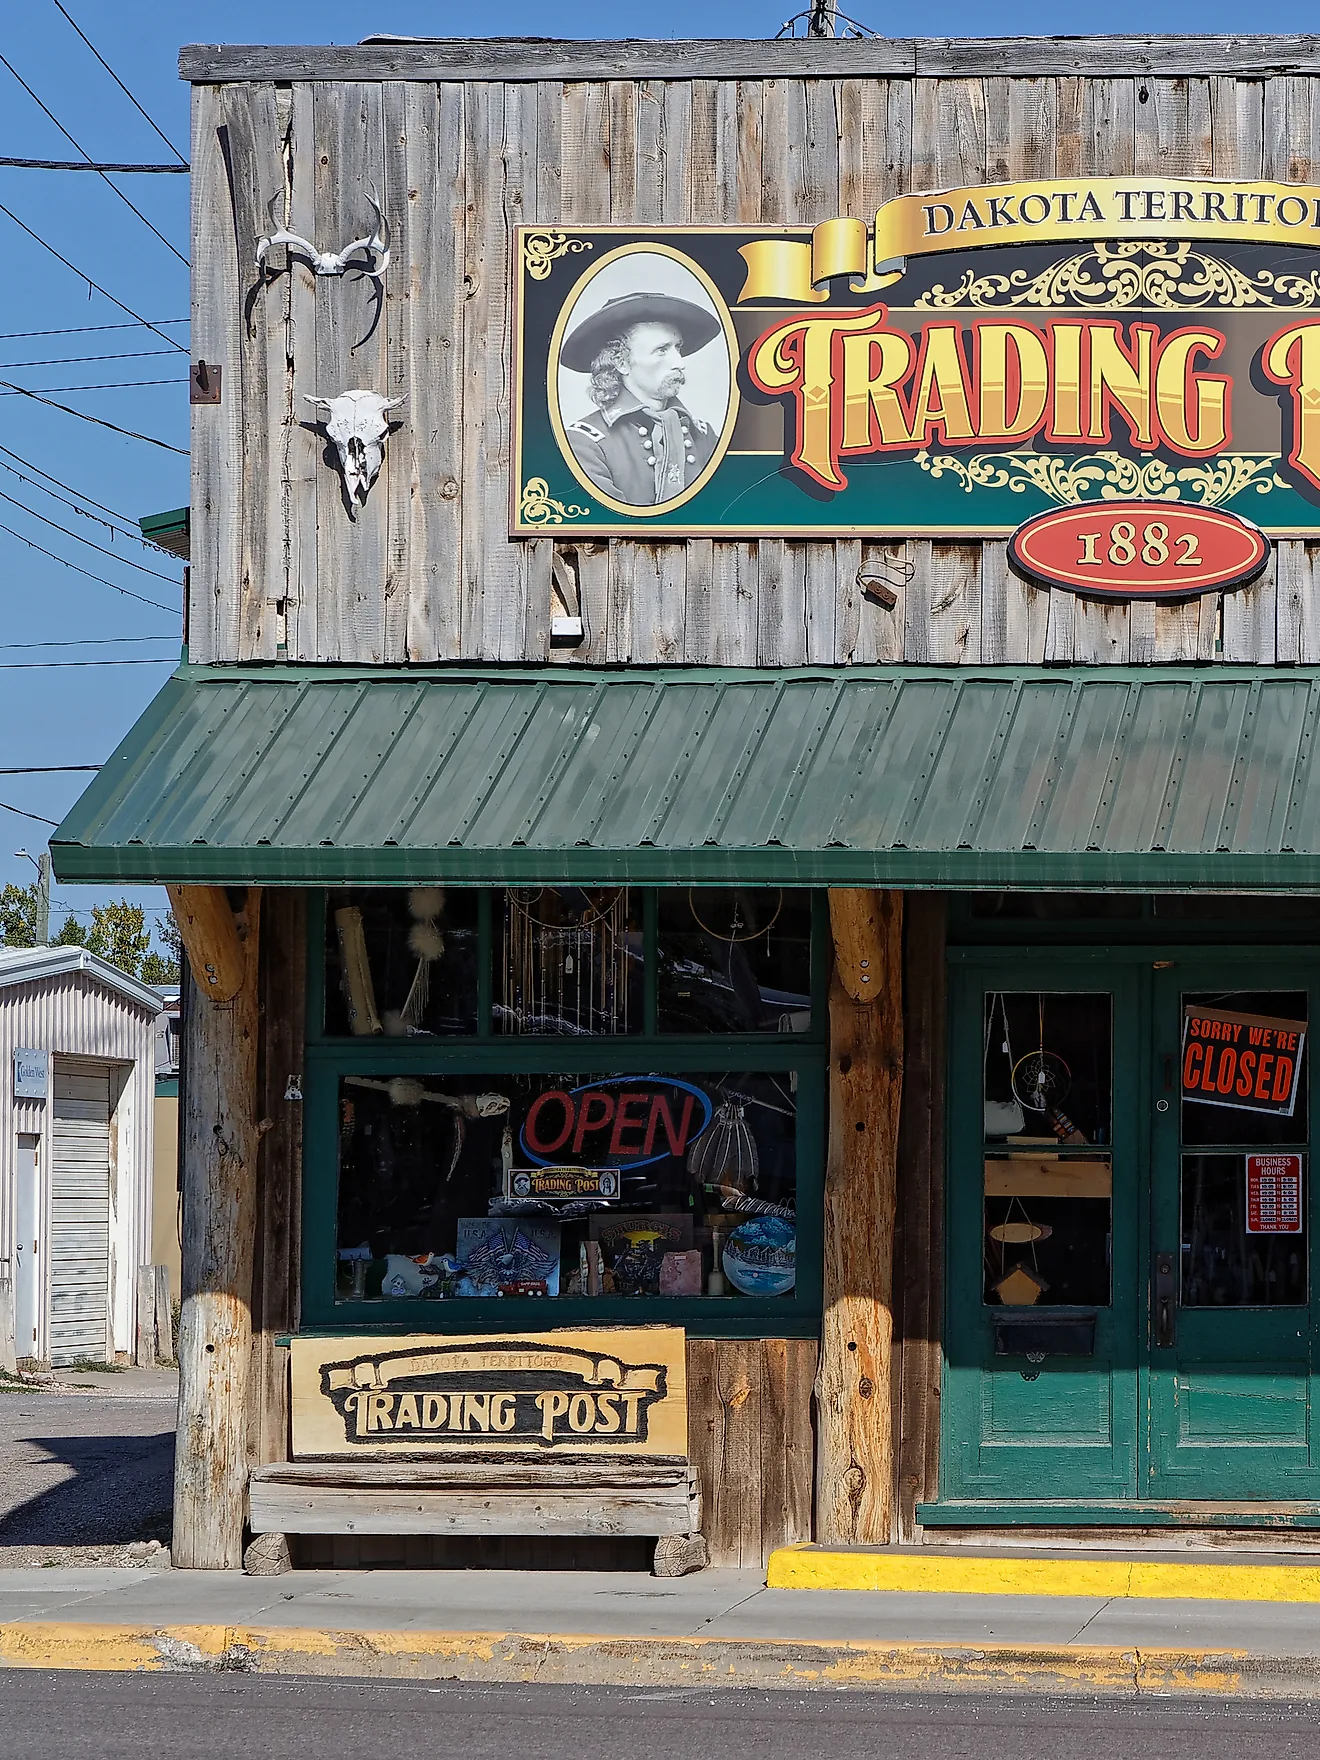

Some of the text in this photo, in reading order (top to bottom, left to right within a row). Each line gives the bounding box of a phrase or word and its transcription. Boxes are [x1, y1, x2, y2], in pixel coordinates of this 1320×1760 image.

[922, 189, 1104, 237] DAKOTA
[750, 303, 1232, 491] TRADING
[1075, 521, 1203, 567] 1882
[1190, 1018, 1297, 1052] SORRY WE'RE
[21, 1065, 35, 1077] Golden
[1182, 1042, 1294, 1103] CLOSED
[524, 1090, 697, 1157] OPEN
[1255, 1158, 1292, 1167] BUSINESS
[1261, 1167, 1286, 1176] HOURS
[531, 1178, 600, 1194] TRADING POST
[601, 1218, 682, 1243] STURGIS
[344, 1388, 647, 1442] TRADING POST
